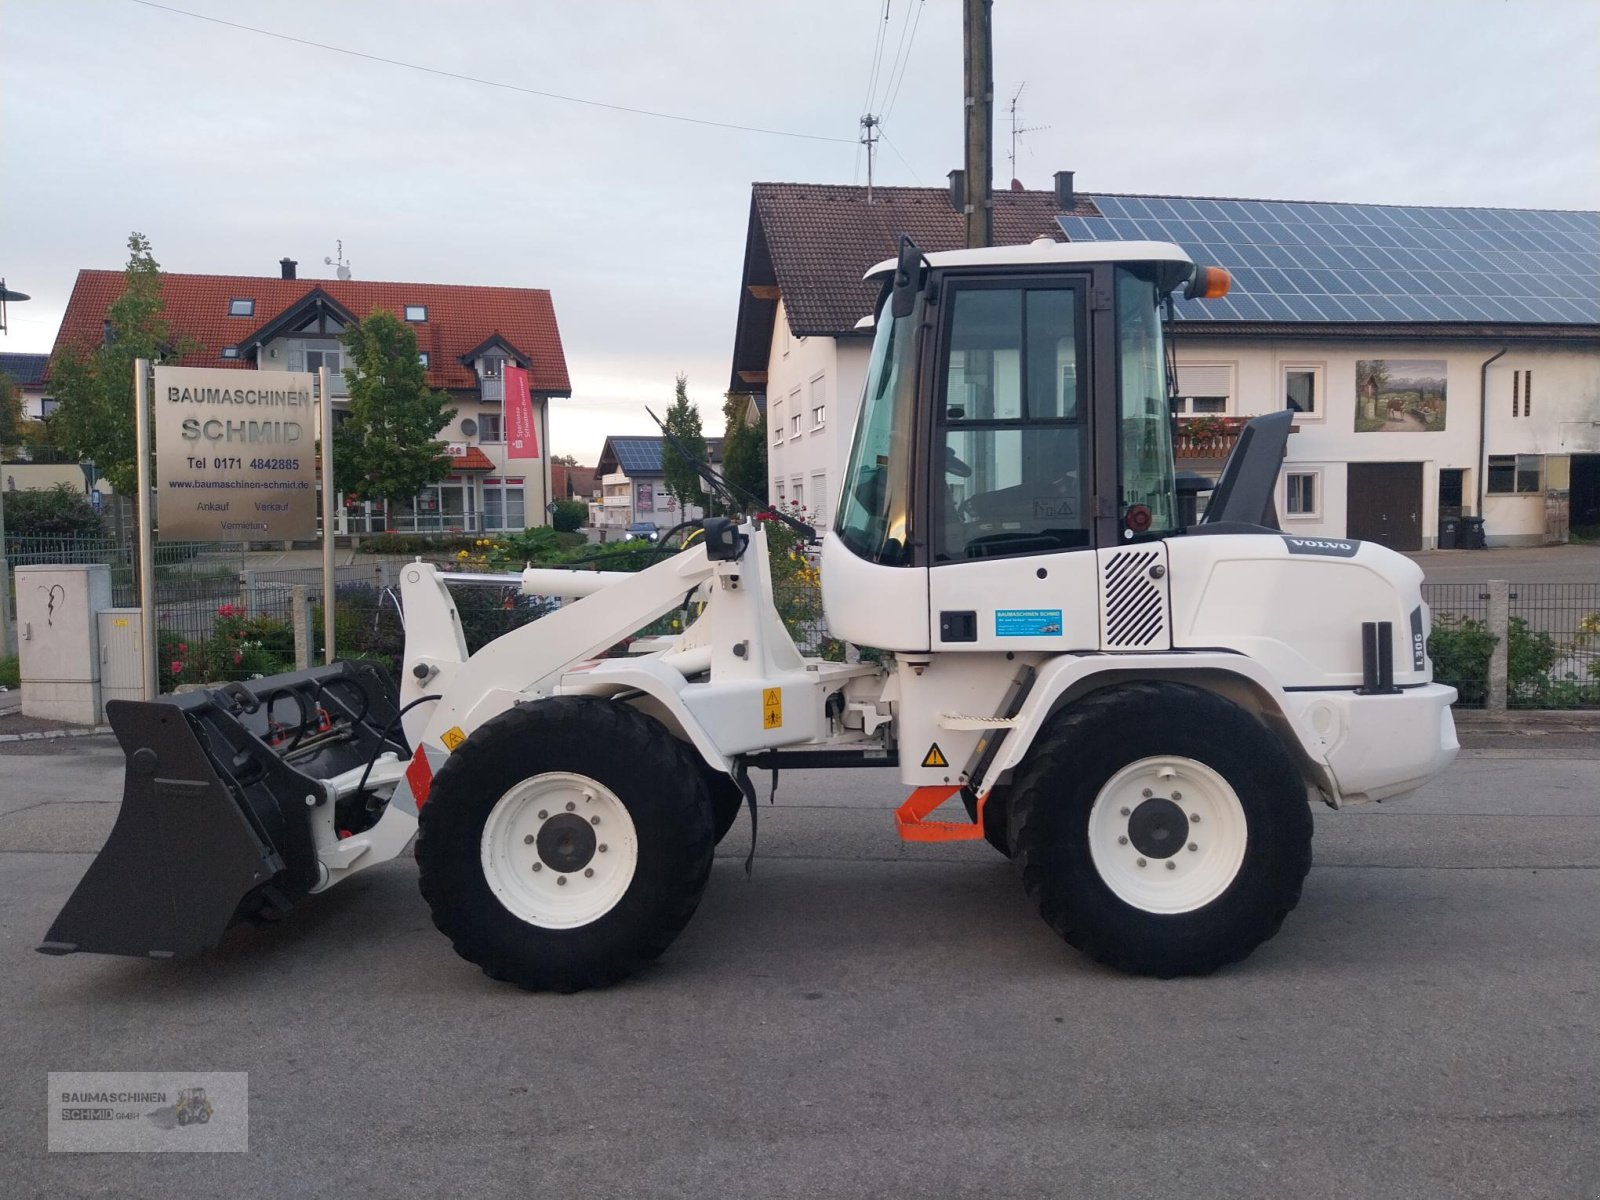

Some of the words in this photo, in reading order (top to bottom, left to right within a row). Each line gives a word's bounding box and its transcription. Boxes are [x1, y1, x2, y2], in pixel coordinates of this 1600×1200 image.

[168, 386, 310, 407] BAUMASCHINEN
[181, 418, 303, 443] SCHMID
[187, 457, 206, 469] Tel
[214, 457, 242, 469] 0171
[250, 458, 299, 470] 4842885
[169, 480, 309, 489] www.baumaschinen-schmid.de
[197, 501, 230, 511] Ankauf
[254, 502, 289, 512] Verkauf
[220, 521, 269, 531] Vermietung
[1290, 539, 1352, 550] VOLVO
[1414, 633, 1424, 665] L30G
